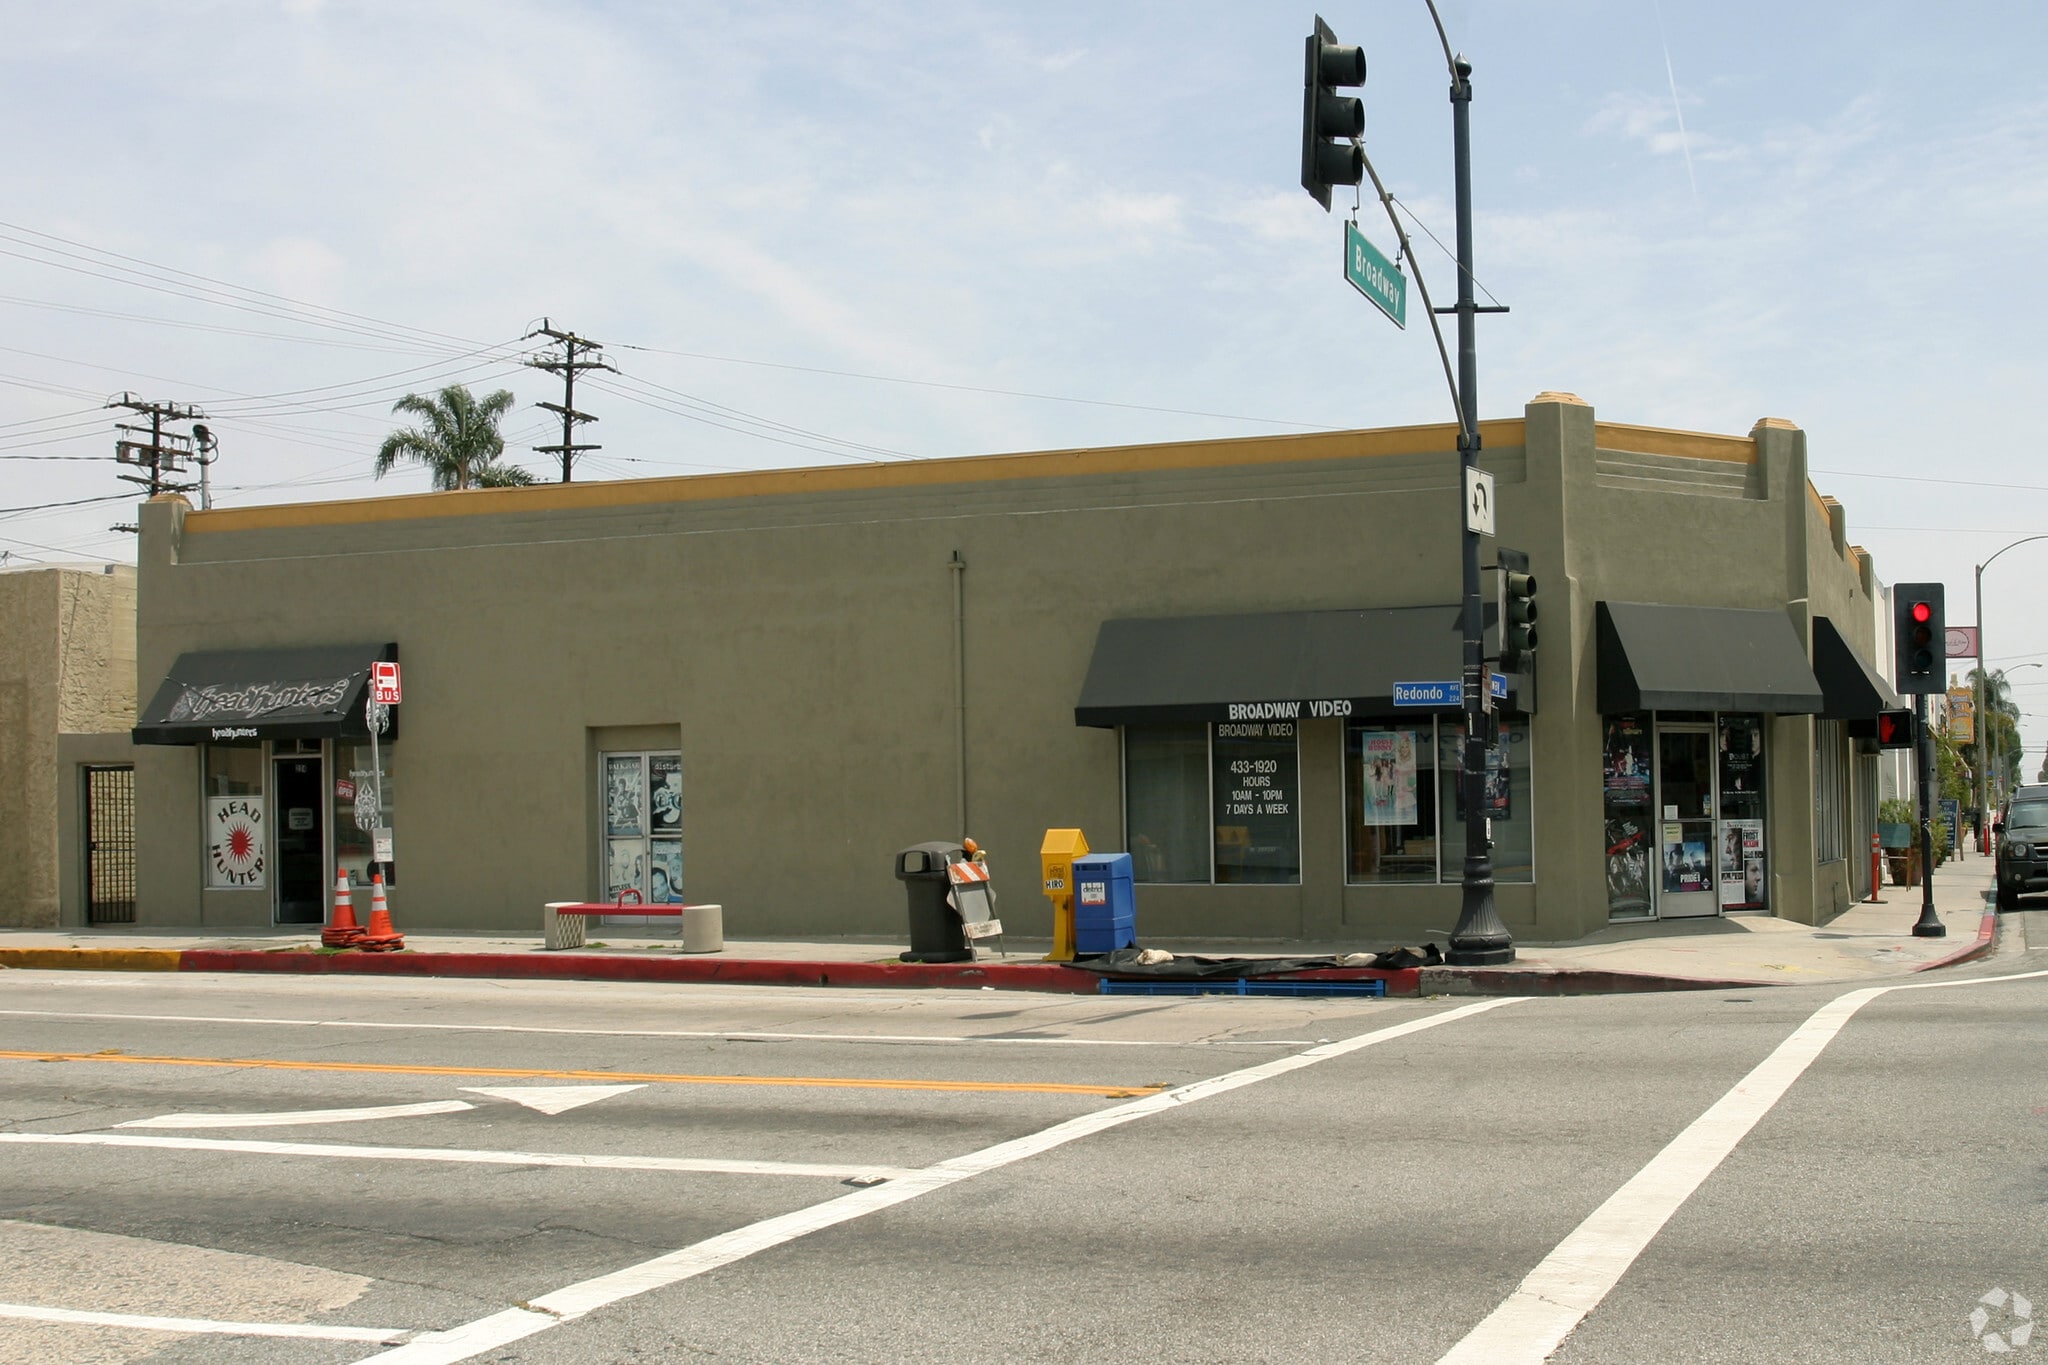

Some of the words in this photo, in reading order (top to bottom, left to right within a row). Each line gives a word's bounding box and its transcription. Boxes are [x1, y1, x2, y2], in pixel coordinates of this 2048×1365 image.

[1355, 244, 1400, 314] Broadway
[376, 690, 399, 701] BUS
[1395, 686, 1443, 701] Redondo
[1229, 702, 1300, 720] BROADWAY
[1310, 700, 1352, 717] VIDEO
[1218, 723, 1264, 737] BROADWAY
[1267, 723, 1293, 736] VIDEO
[1230, 760, 1277, 773] 433-1920
[1242, 776, 1271, 787] HOURS
[1231, 790, 1252, 801] 10AM
[1263, 790, 1283, 800] 10PM
[217, 800, 262, 824] HEAD
[1225, 804, 1231, 815] 7
[1233, 804, 1254, 815] DAYS
[1256, 804, 1263, 814] A
[1265, 804, 1289, 814] WEEK
[211, 843, 264, 885] HUNTER
